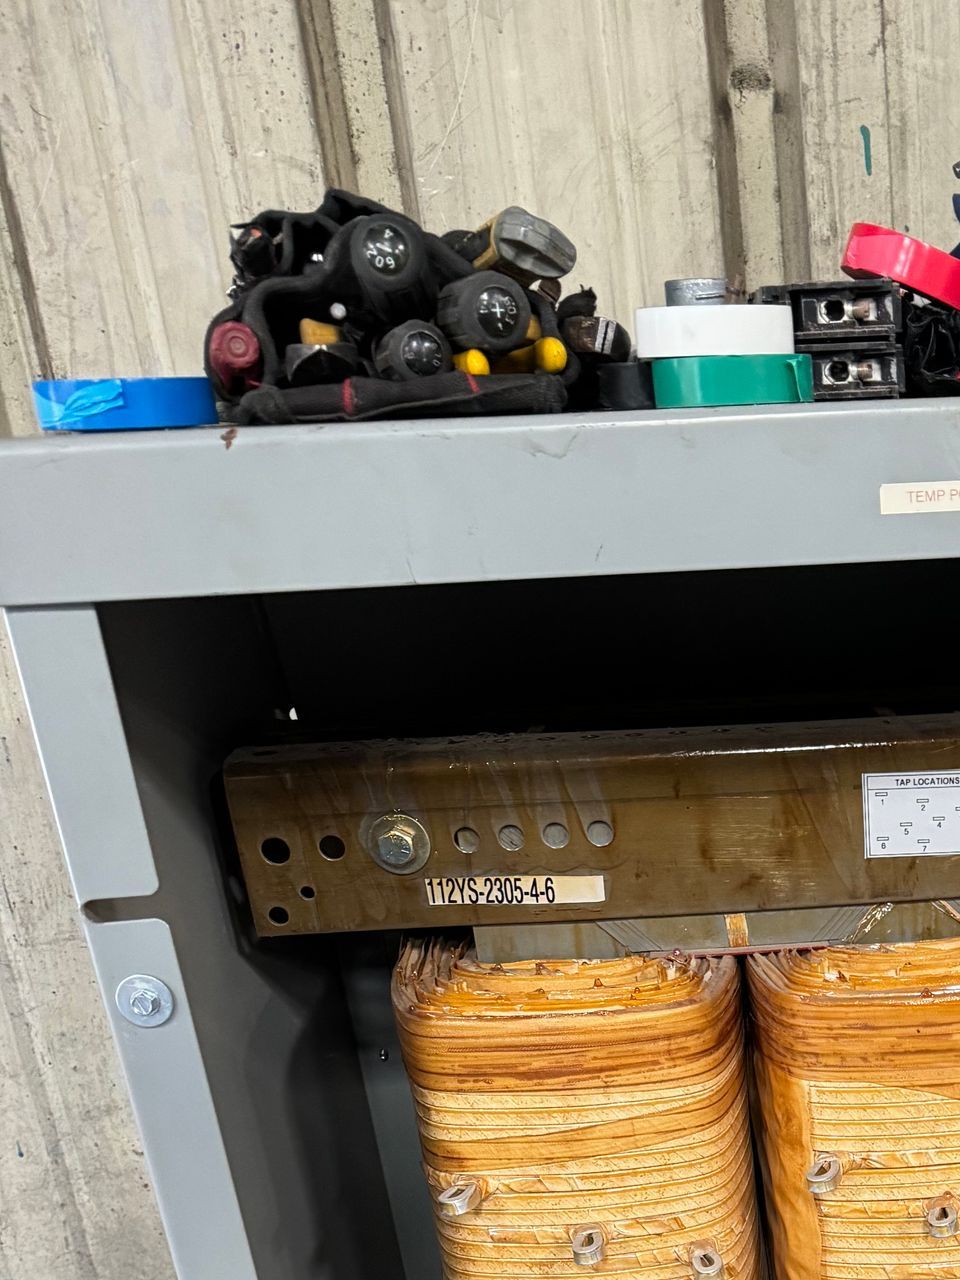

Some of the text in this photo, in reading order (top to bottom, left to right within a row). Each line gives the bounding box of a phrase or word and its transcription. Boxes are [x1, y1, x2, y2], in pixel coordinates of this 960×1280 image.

[906, 489, 946, 503] TEMP
[895, 776, 960, 787] TAP LOCATIONS
[427, 877, 556, 904] 112YS-2305-4-6
